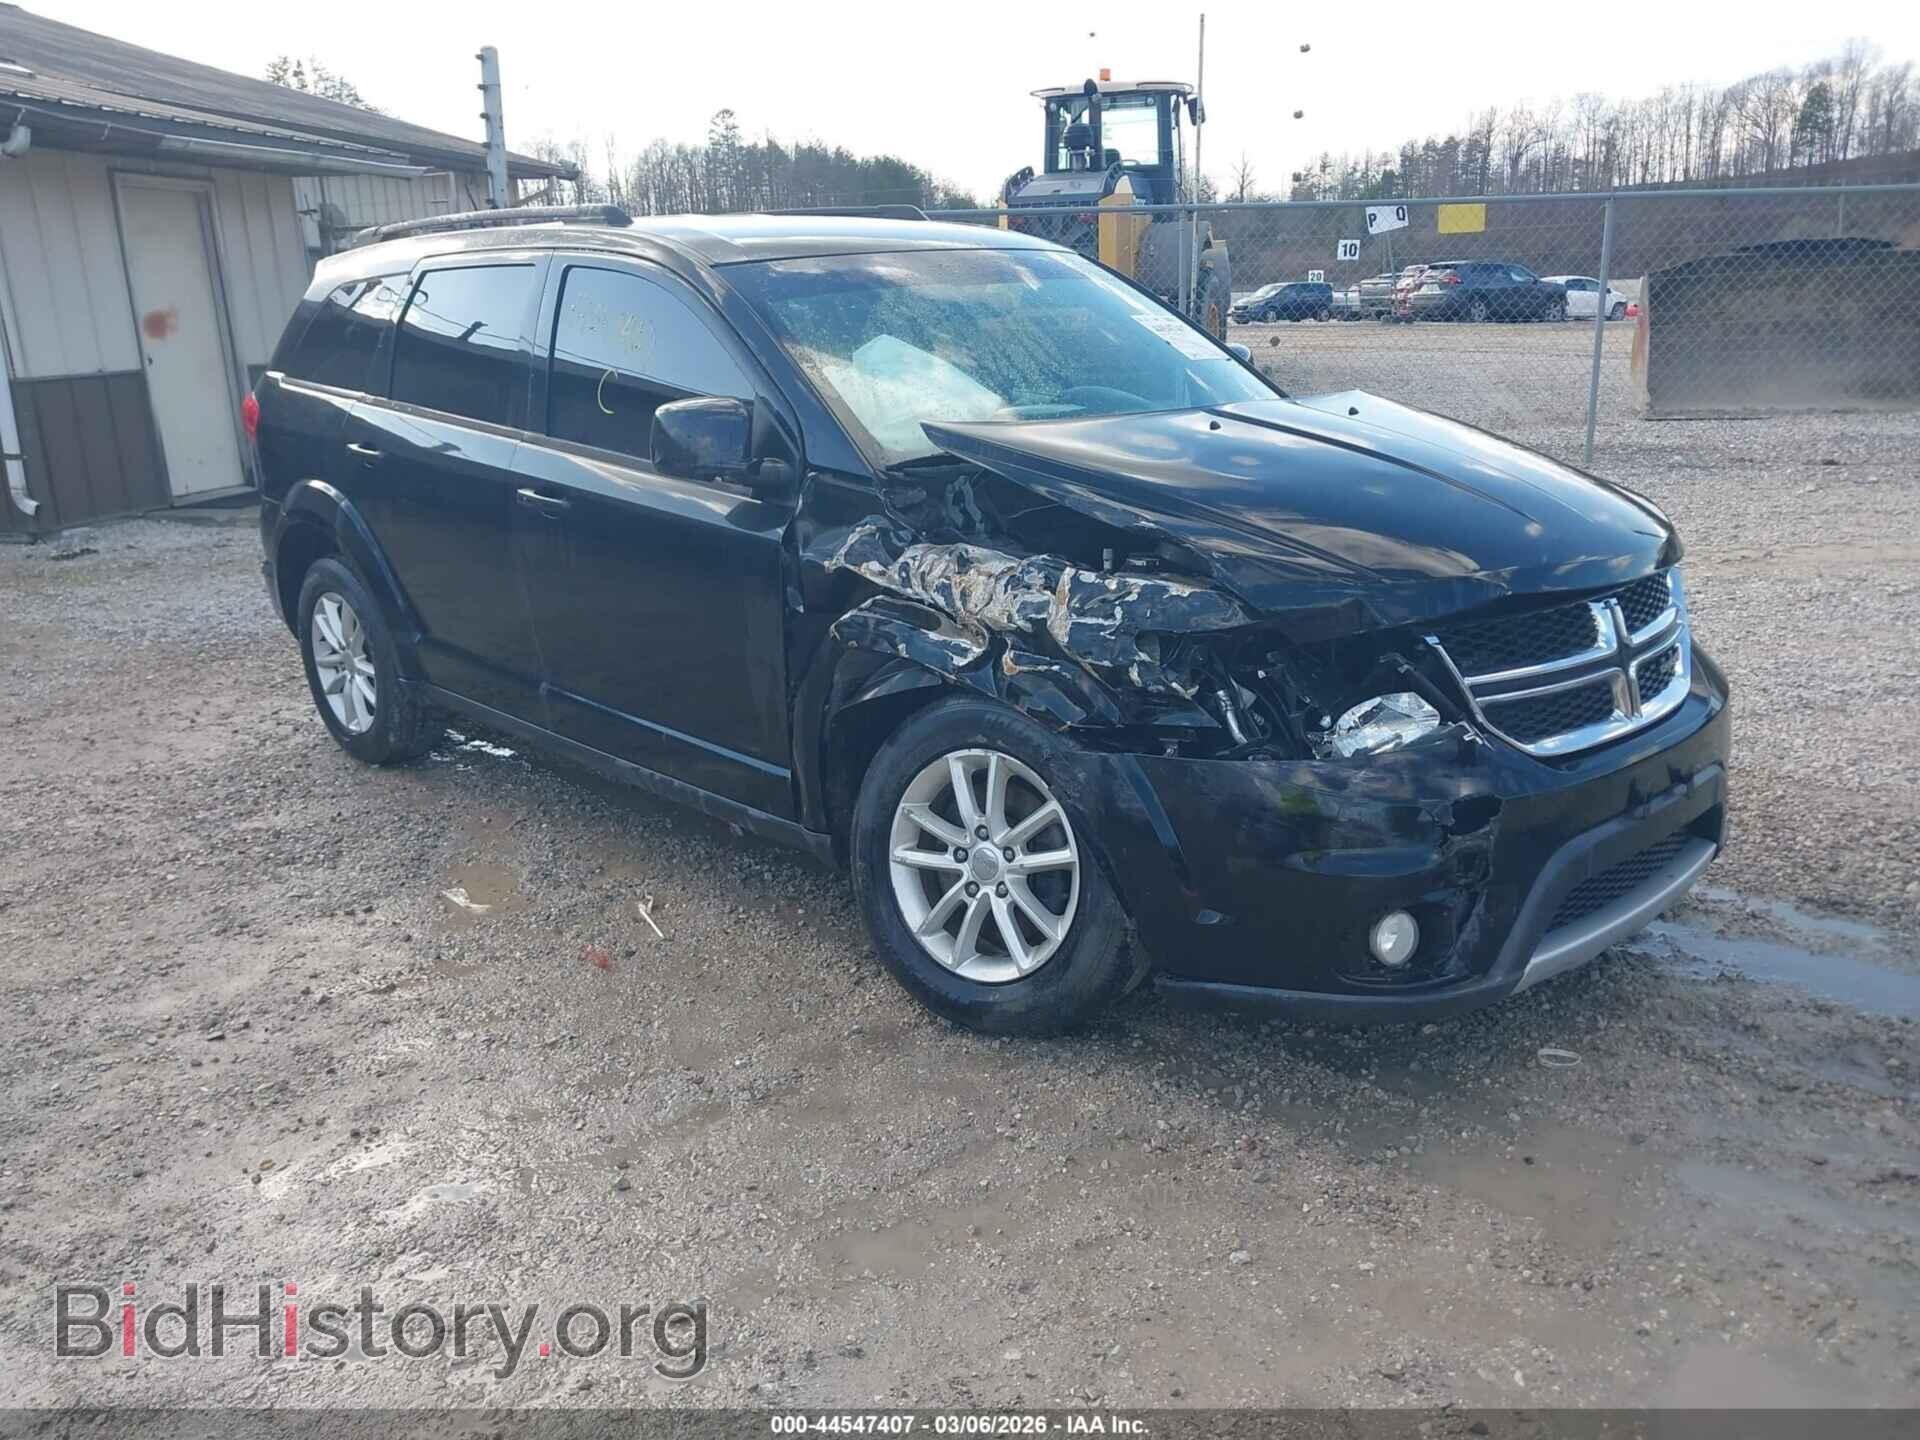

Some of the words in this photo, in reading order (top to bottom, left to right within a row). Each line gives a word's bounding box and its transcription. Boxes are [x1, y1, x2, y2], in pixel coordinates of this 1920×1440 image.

[1368, 213, 1377, 228] P
[1341, 243, 1358, 257] 10
[1310, 272, 1322, 281] 20
